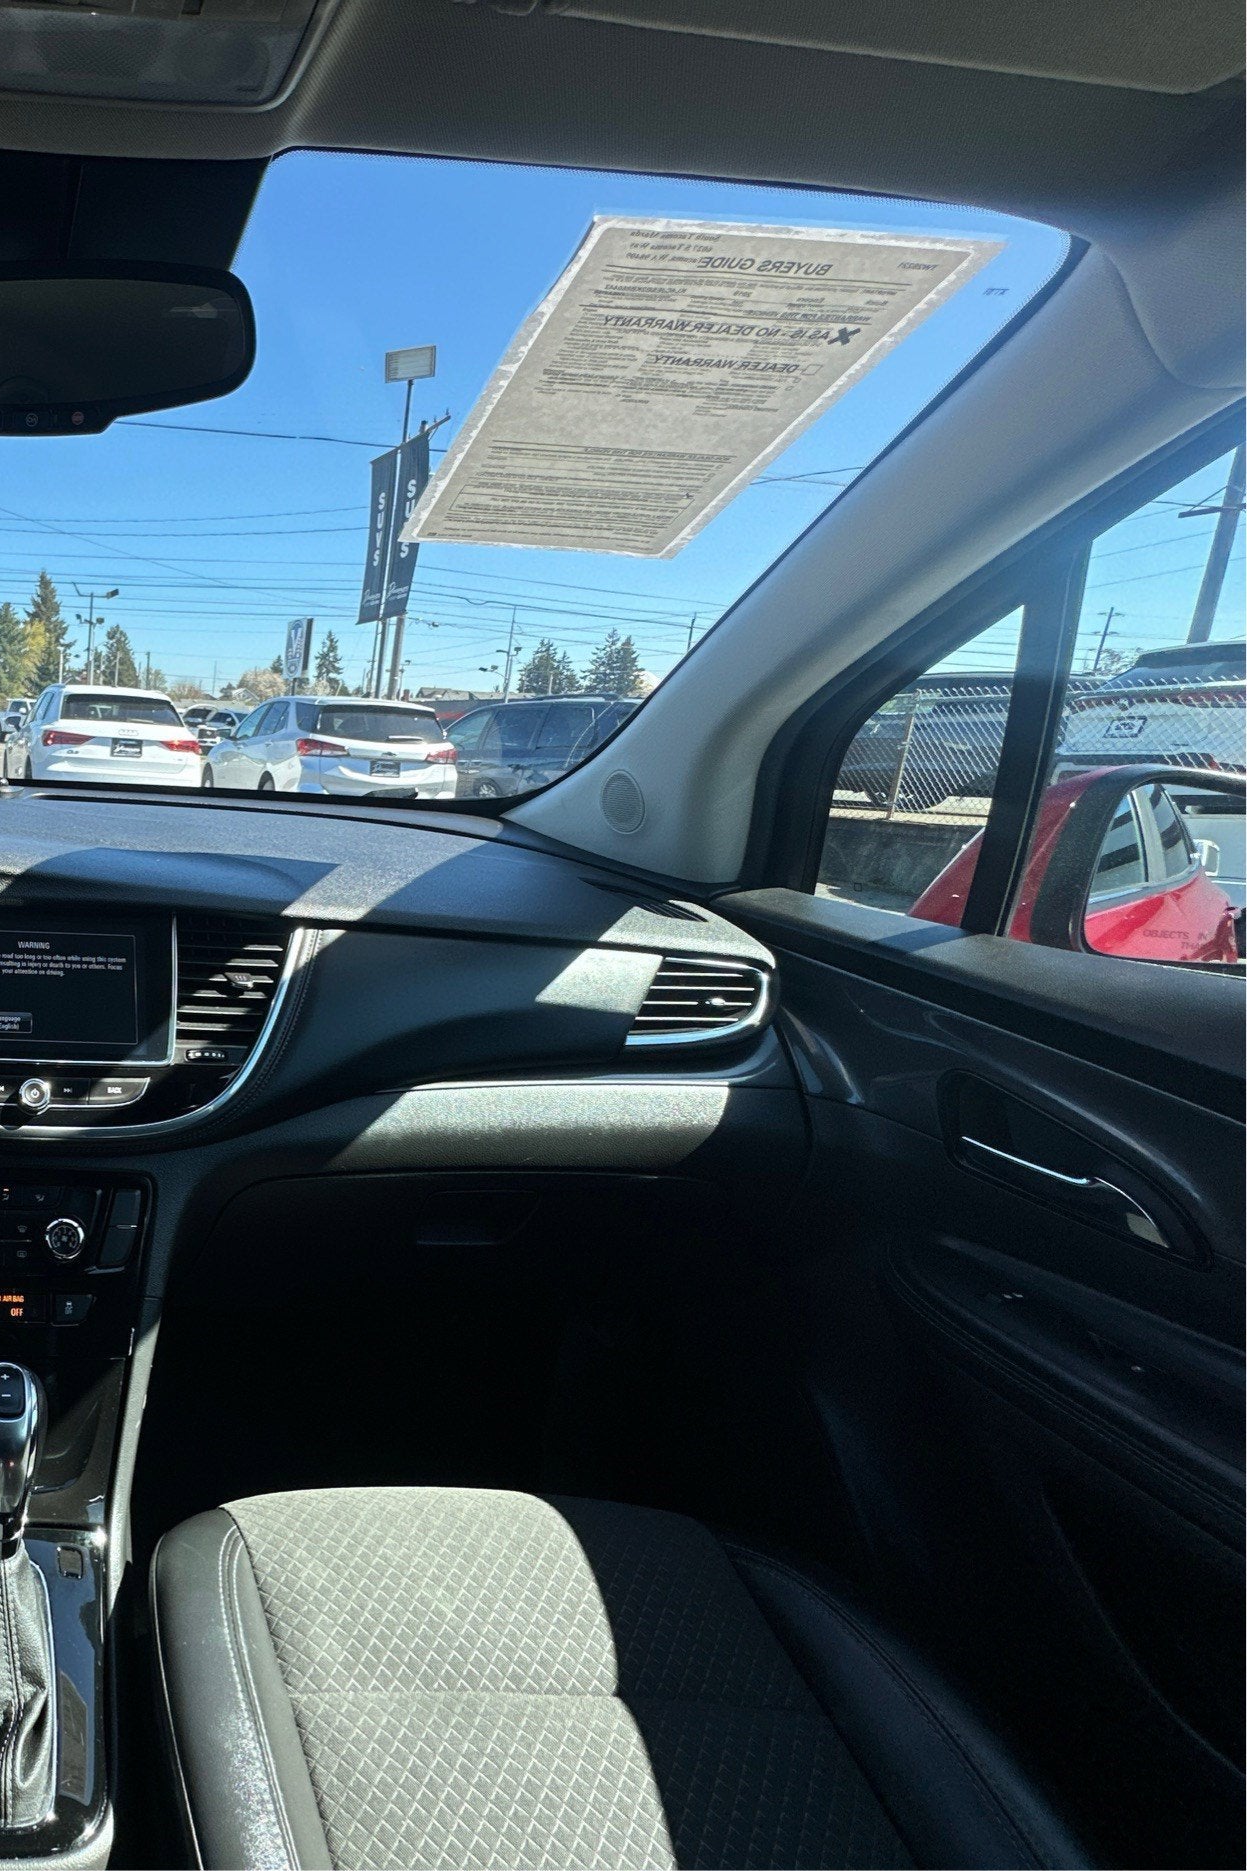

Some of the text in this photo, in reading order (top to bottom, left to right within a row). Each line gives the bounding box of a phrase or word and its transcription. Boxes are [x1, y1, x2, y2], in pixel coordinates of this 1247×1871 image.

[400, 479, 416, 558] SUS
[373, 492, 385, 567] SUVS
[1143, 929, 1189, 939] OBJECTS
[18, 941, 50, 949] WARNING
[107, 1086, 122, 1094] BACK
[2, 1294, 13, 1302] AIR
[12, 1295, 24, 1303] BAG
[10, 1308, 24, 1317] OFF
